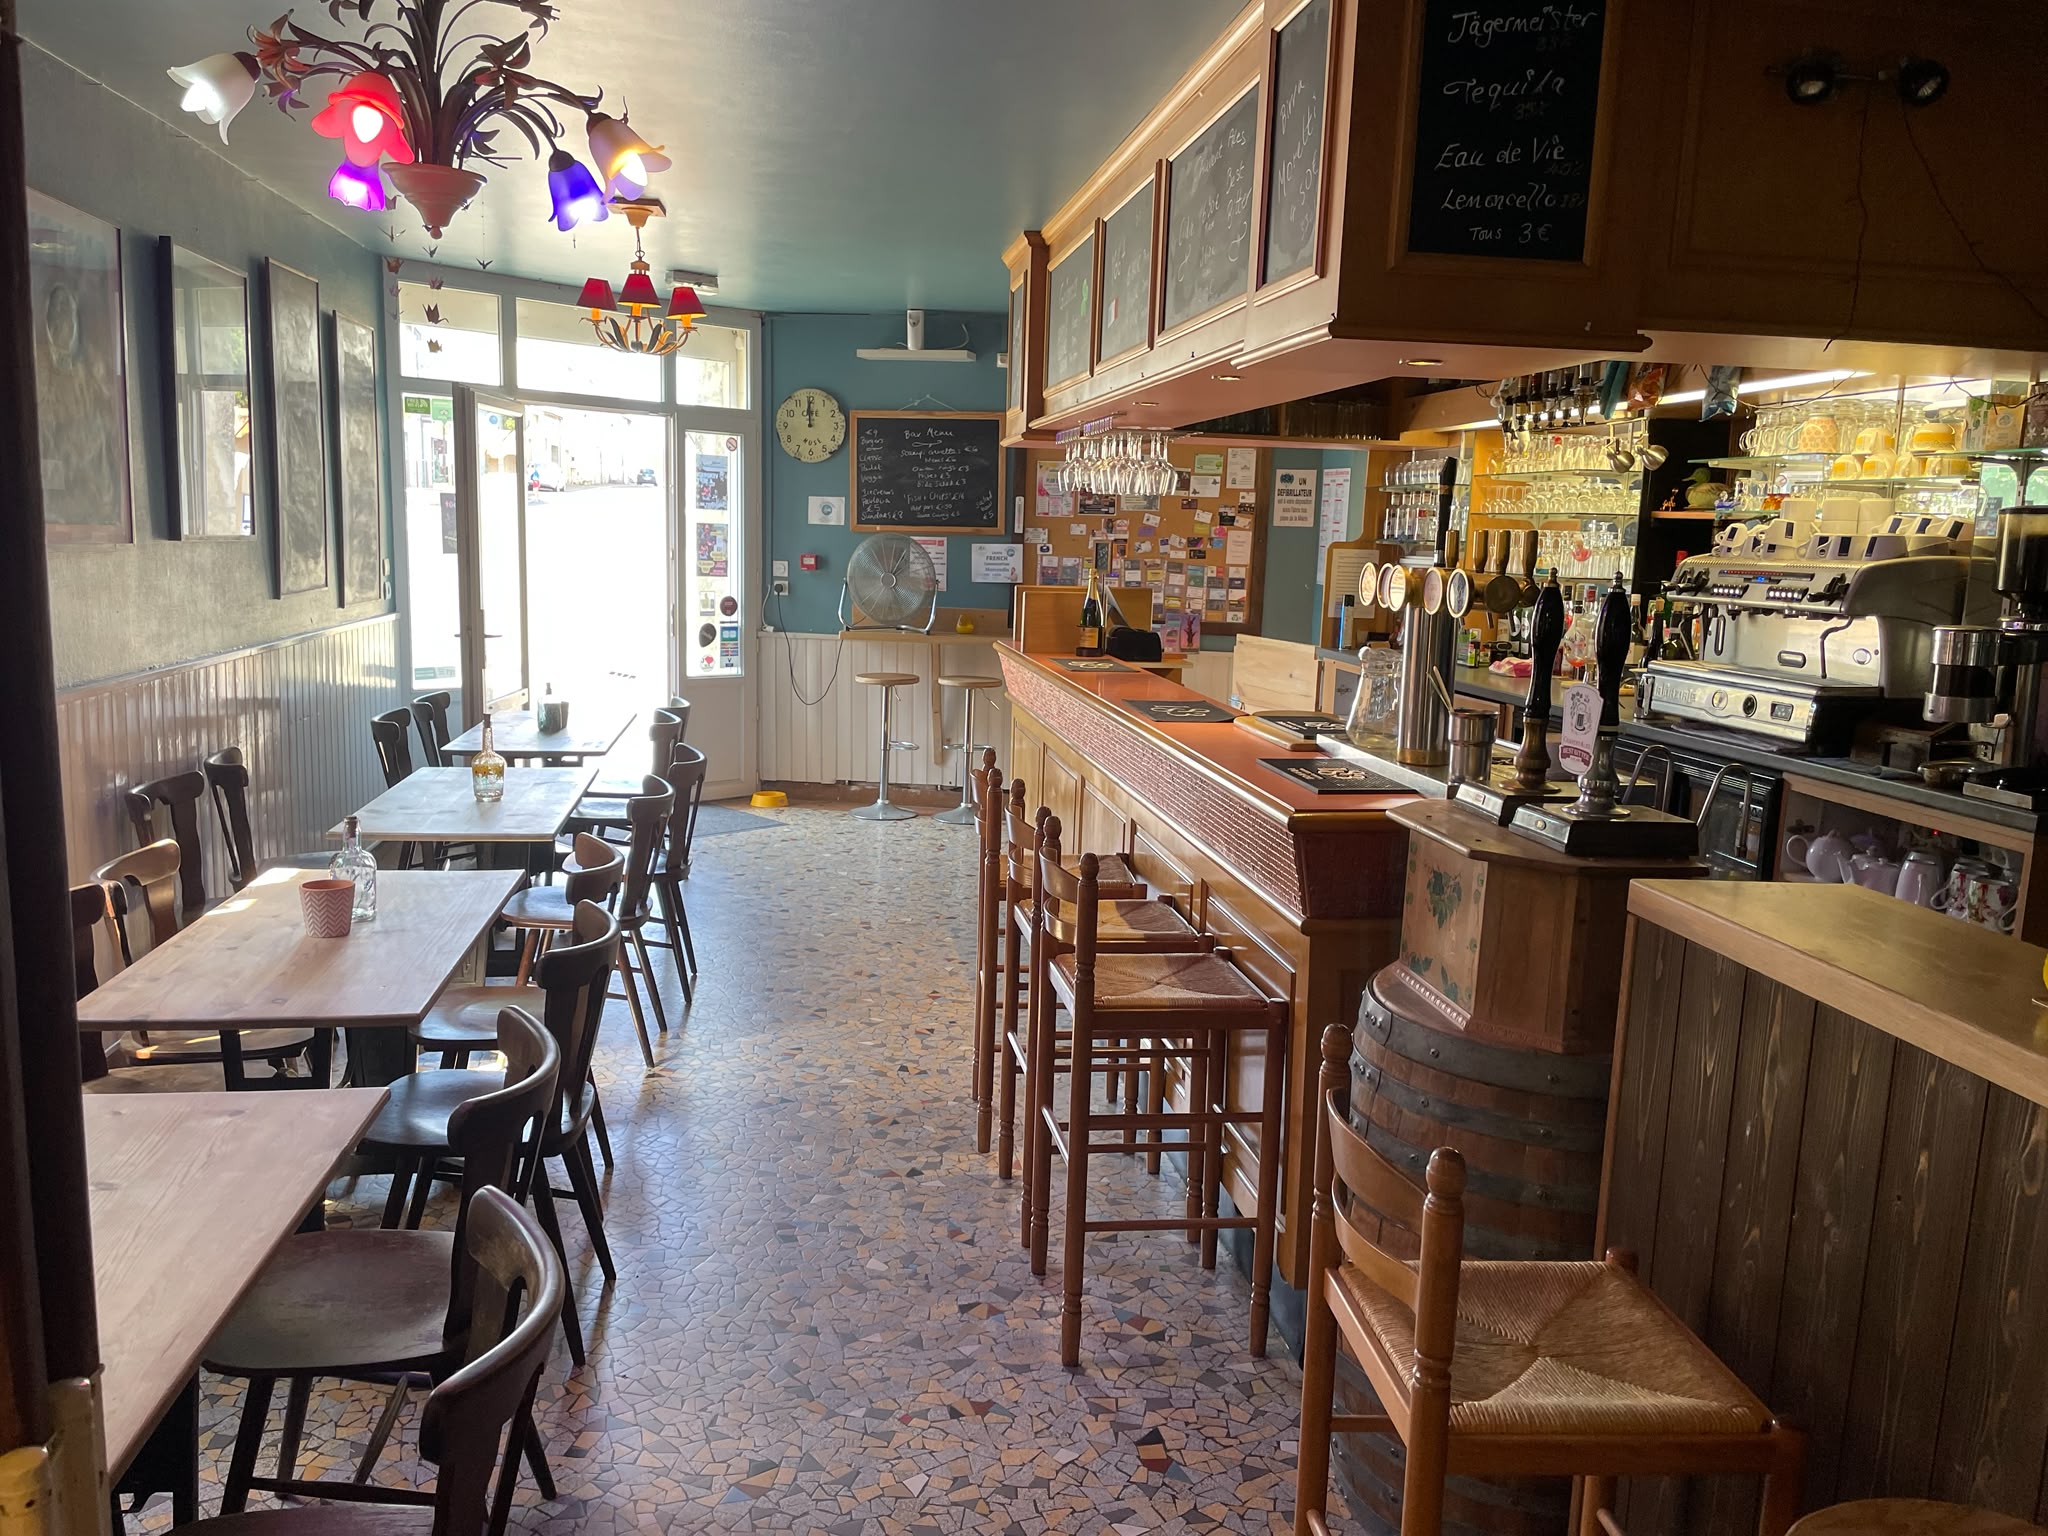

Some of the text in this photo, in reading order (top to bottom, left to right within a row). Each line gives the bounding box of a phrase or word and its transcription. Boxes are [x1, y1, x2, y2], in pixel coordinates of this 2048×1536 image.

[1447, 4, 1598, 48] Jägermeister
[1443, 68, 1565, 112] Tequila
[1433, 142, 1488, 172] Eau
[1495, 139, 1522, 165] de
[1440, 182, 1557, 212] Lemoncello
[1469, 222, 1552, 243] Tous 3 €
[795, 400, 801, 408] 11
[786, 410, 794, 418] 10
[830, 410, 836, 418] 2
[782, 422, 788, 430] 9
[834, 422, 839, 430] 3
[904, 427, 954, 440] Bar Menu
[786, 434, 792, 443] 8
[796, 444, 800, 452] 7
[808, 448, 814, 456] 6
[822, 444, 827, 452] 5
